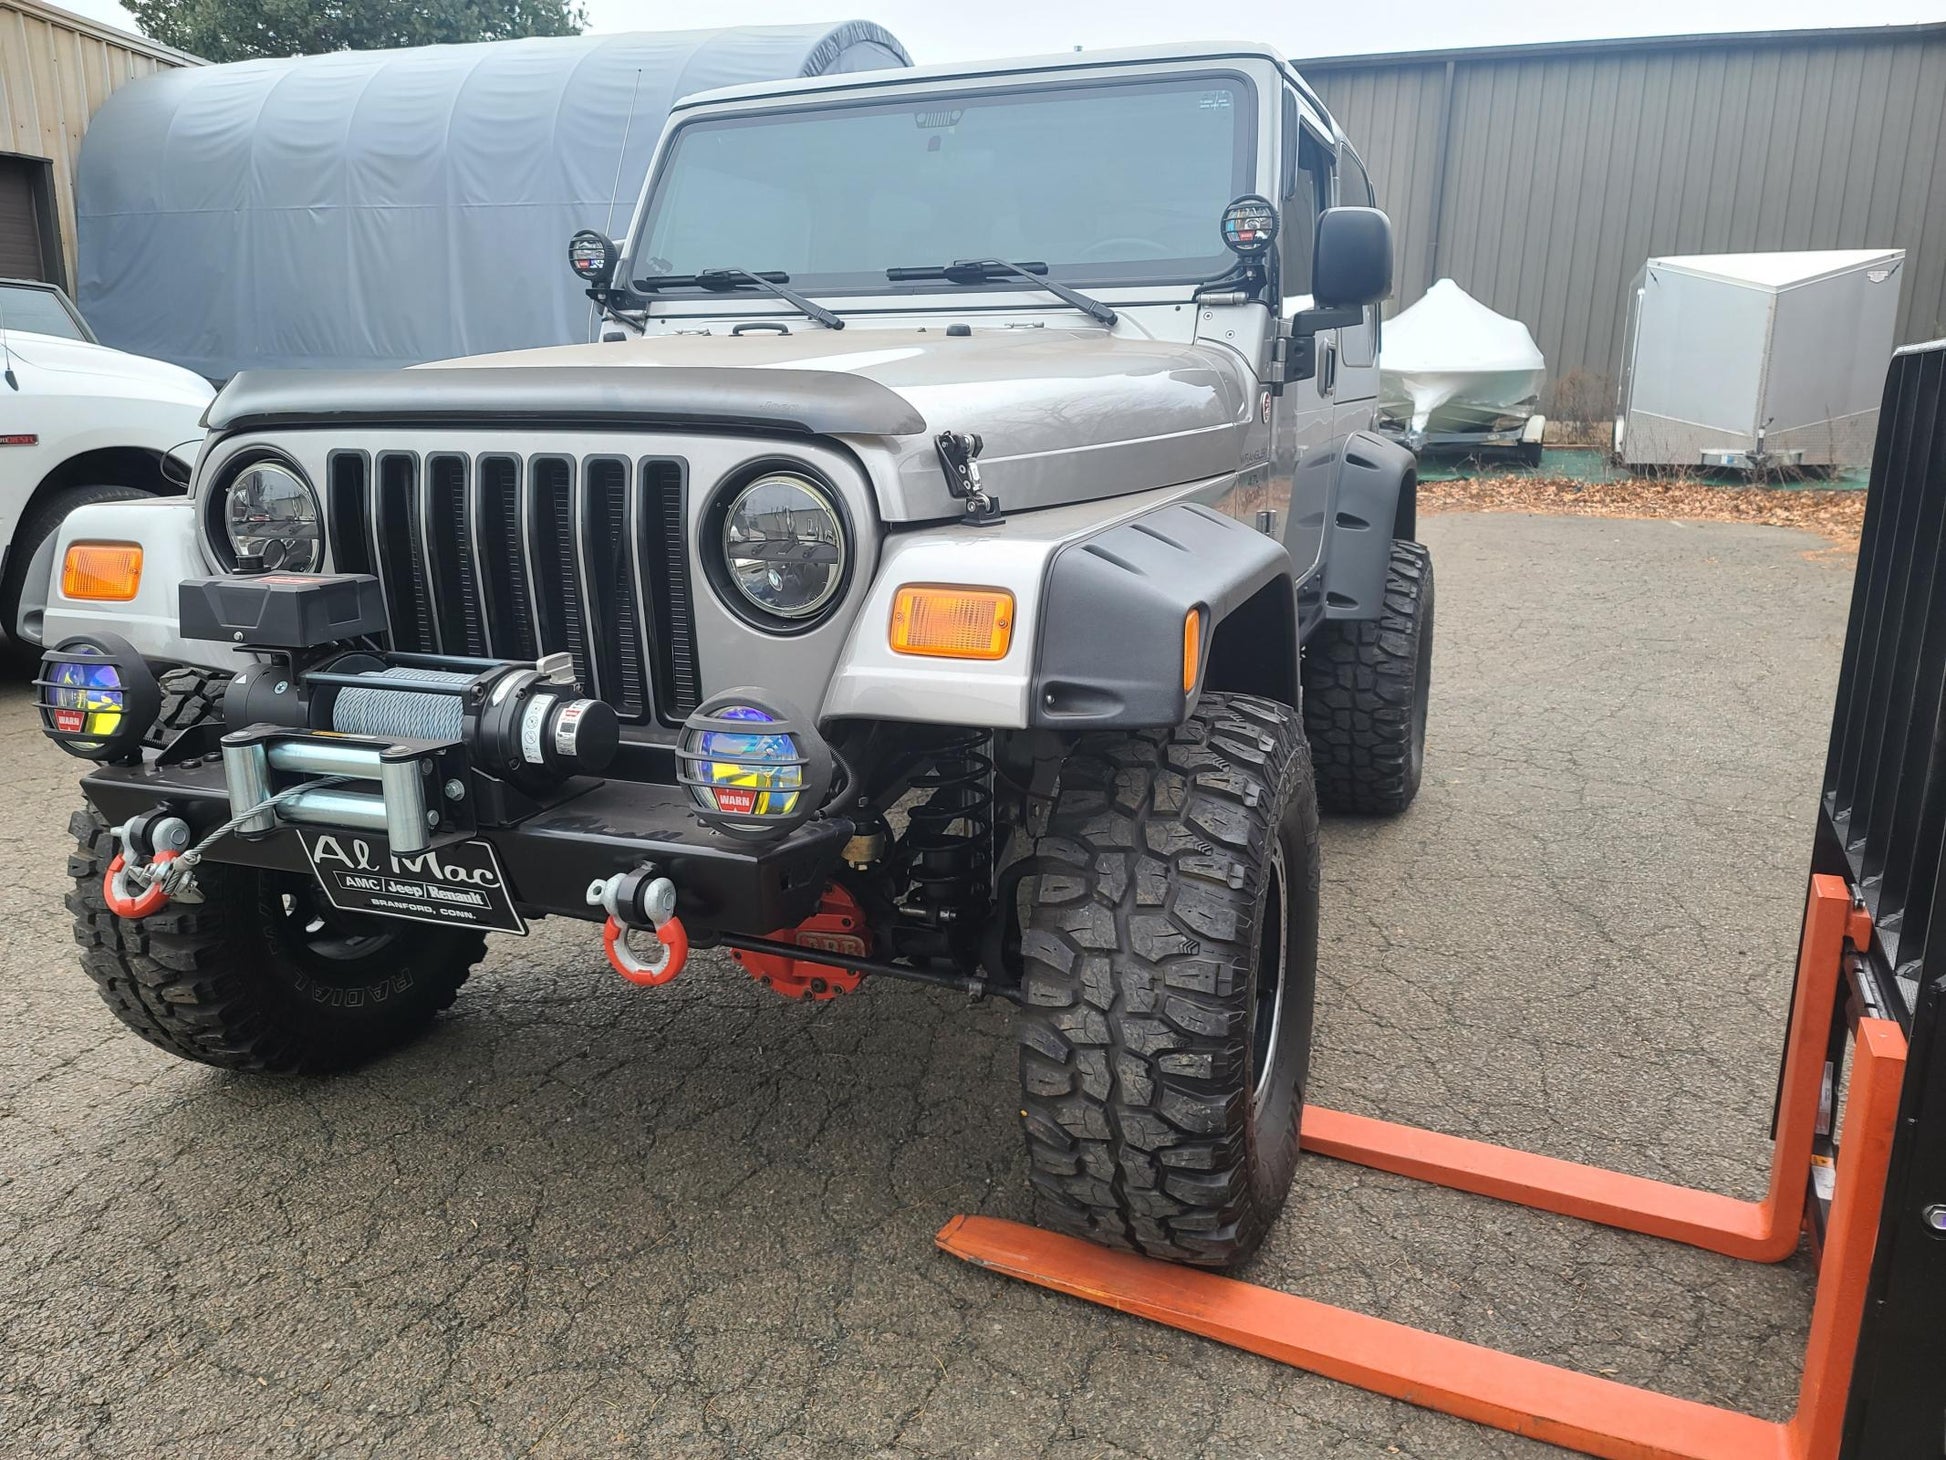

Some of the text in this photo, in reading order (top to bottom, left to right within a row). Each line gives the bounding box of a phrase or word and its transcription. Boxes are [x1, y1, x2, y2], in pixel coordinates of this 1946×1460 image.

[58, 716, 79, 725] WARN
[720, 795, 750, 806] WARN
[313, 835, 501, 888] Al Mac
[345, 876, 484, 906] AMC Jeep Renault
[370, 898, 477, 920] BRANFORD, CONN.
[294, 968, 415, 1008] RADIAL
